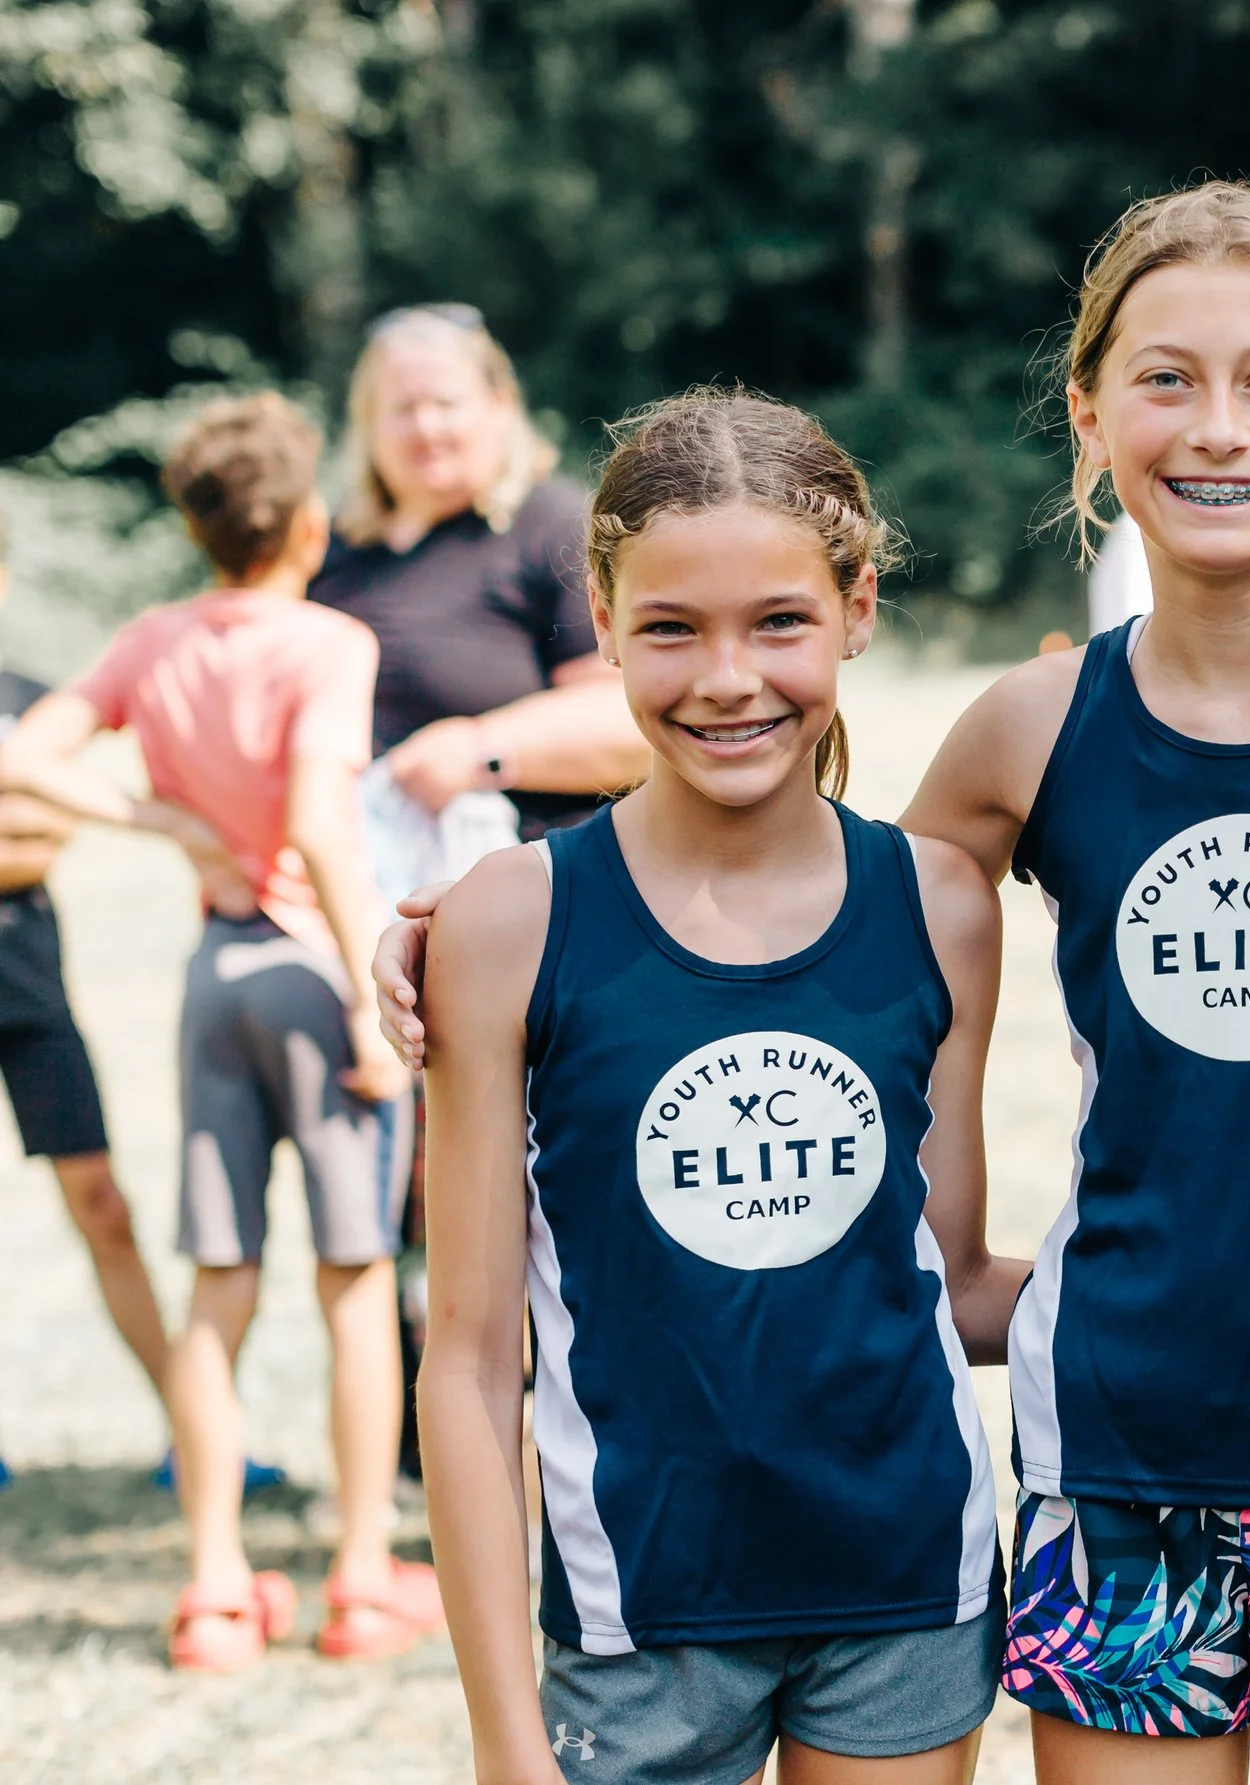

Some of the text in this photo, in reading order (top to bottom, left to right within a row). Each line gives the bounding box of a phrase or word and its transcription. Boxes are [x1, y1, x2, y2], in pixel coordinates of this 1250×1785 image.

[1126, 836, 1223, 925] YOUTH
[646, 1048, 877, 1141] YOUTH RUNNER
[672, 1135, 857, 1190] ELITE
[725, 1195, 812, 1221] CAMP
